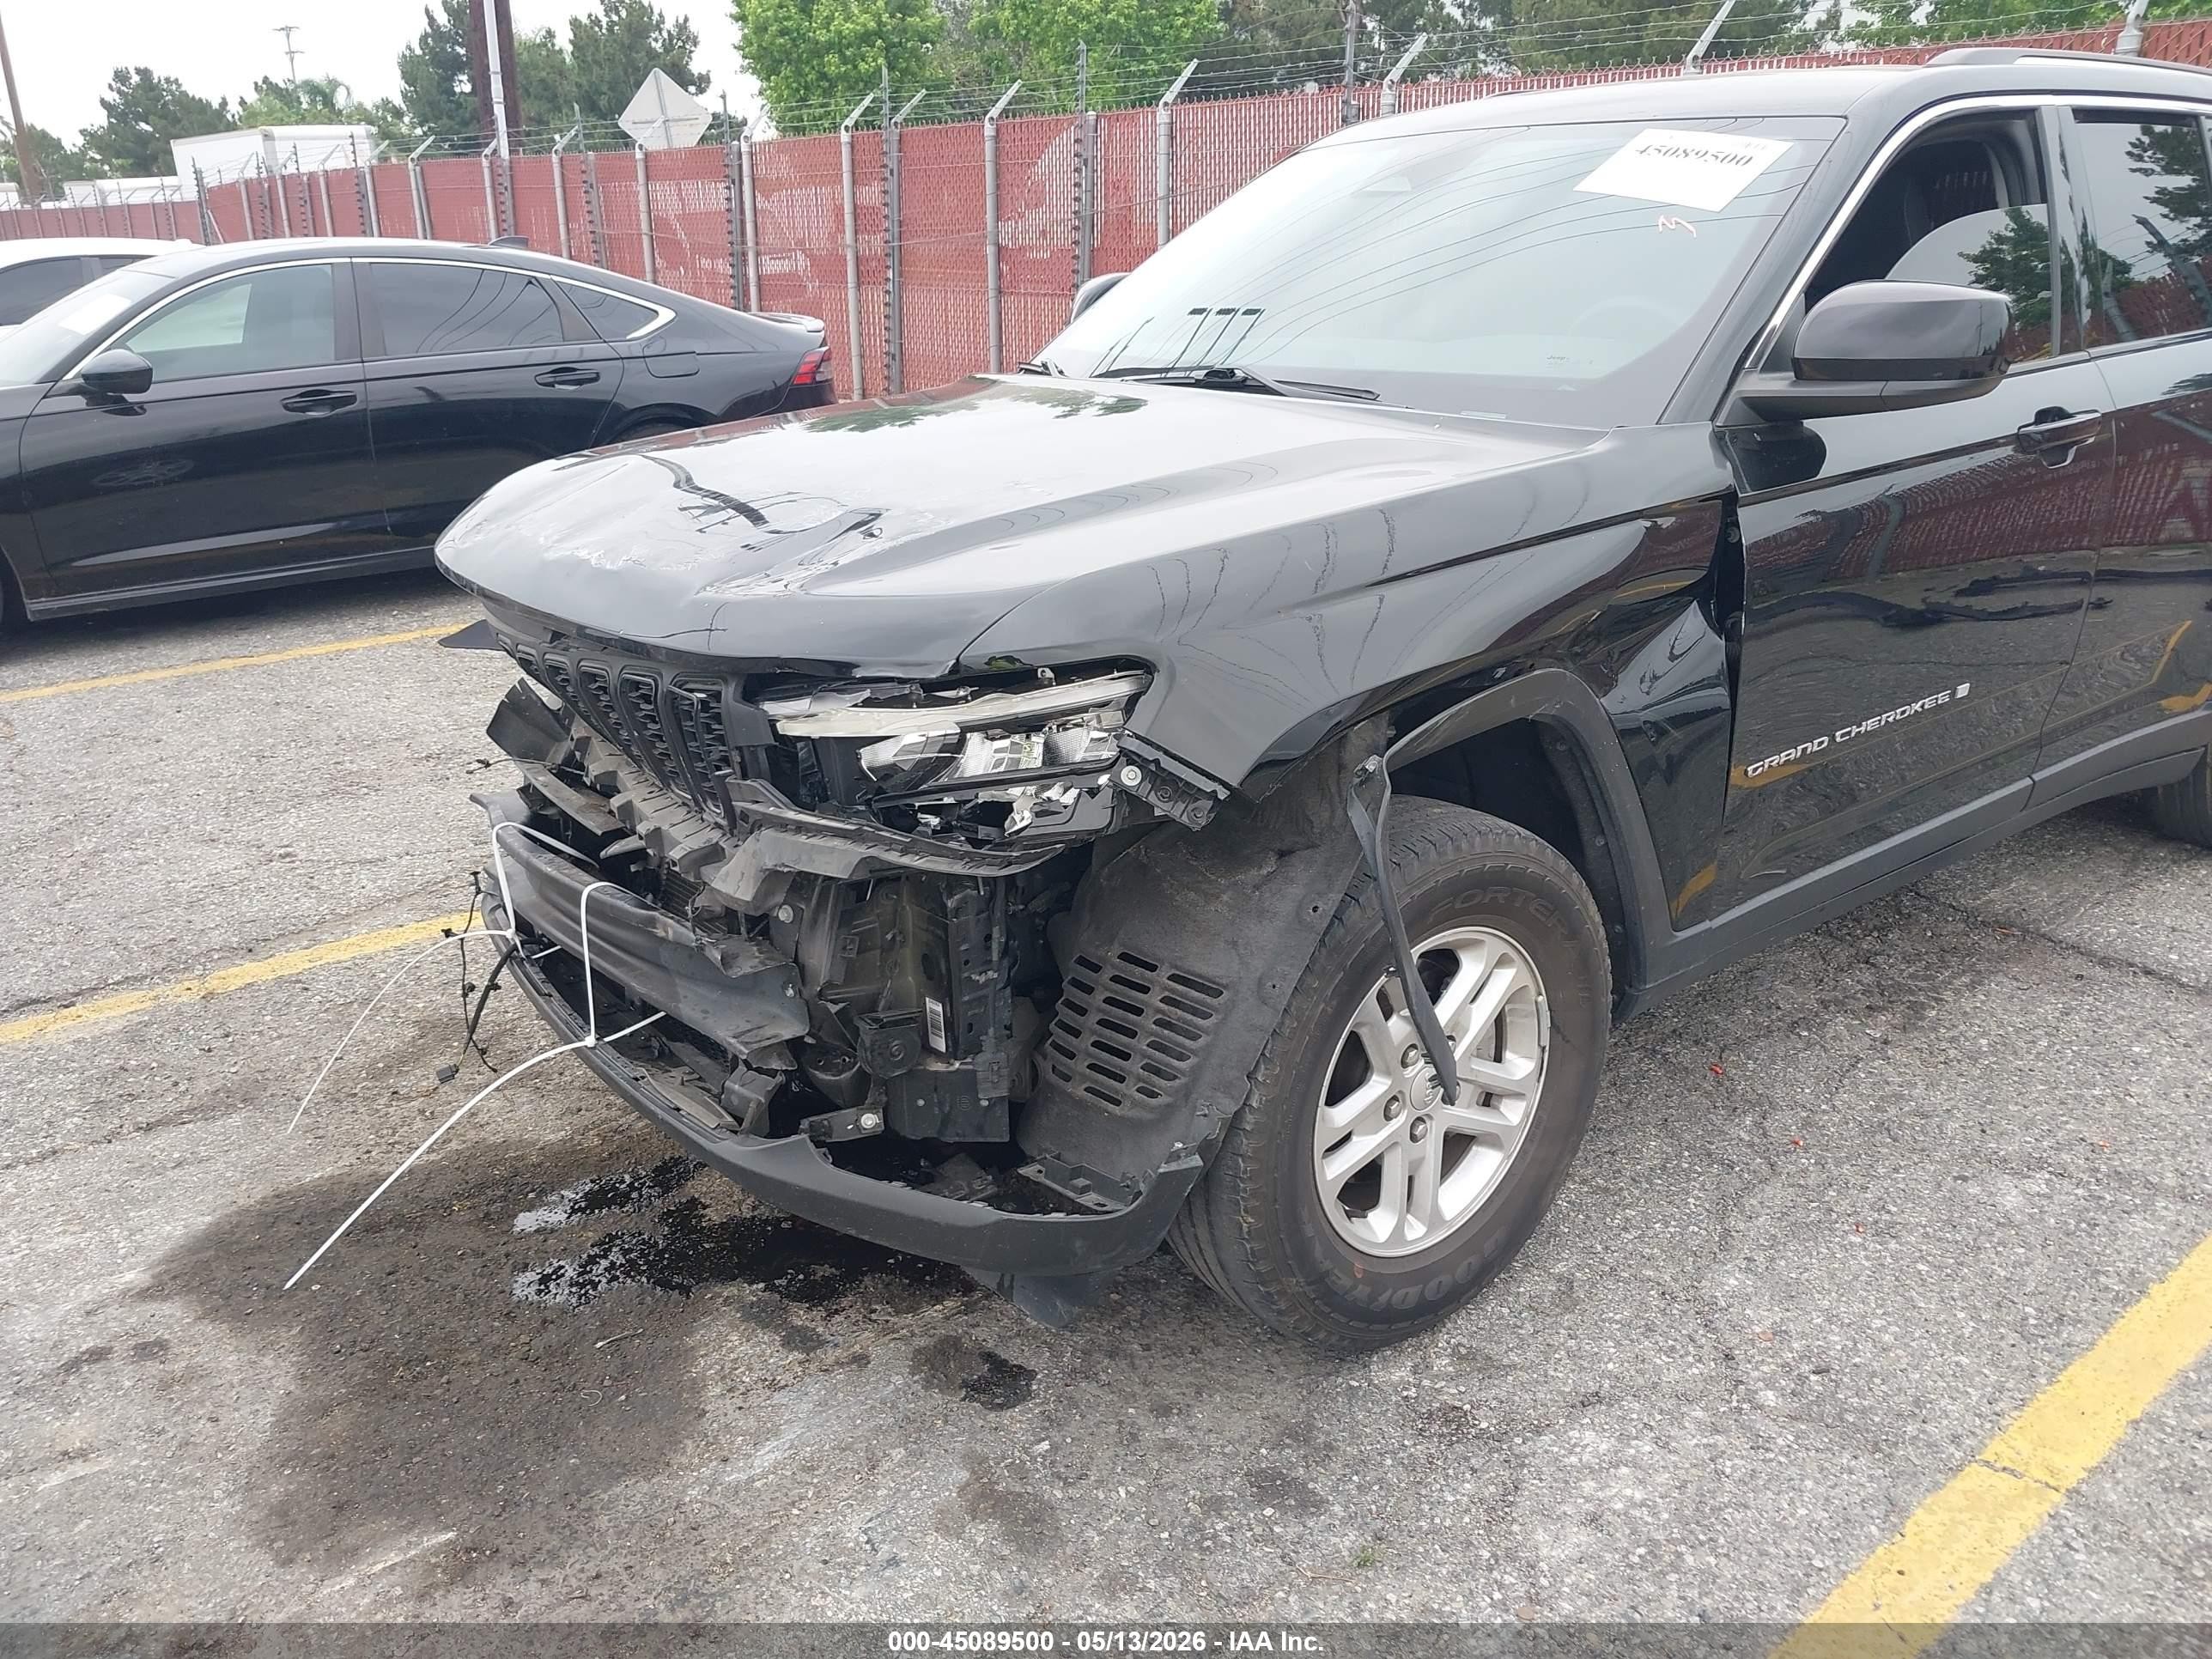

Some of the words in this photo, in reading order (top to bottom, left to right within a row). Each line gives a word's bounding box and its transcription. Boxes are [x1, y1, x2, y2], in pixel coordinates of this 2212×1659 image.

[1635, 143, 1754, 167] 45089500
[1745, 735, 1829, 779] GRAND
[1834, 689, 1952, 744] CHEROKEE
